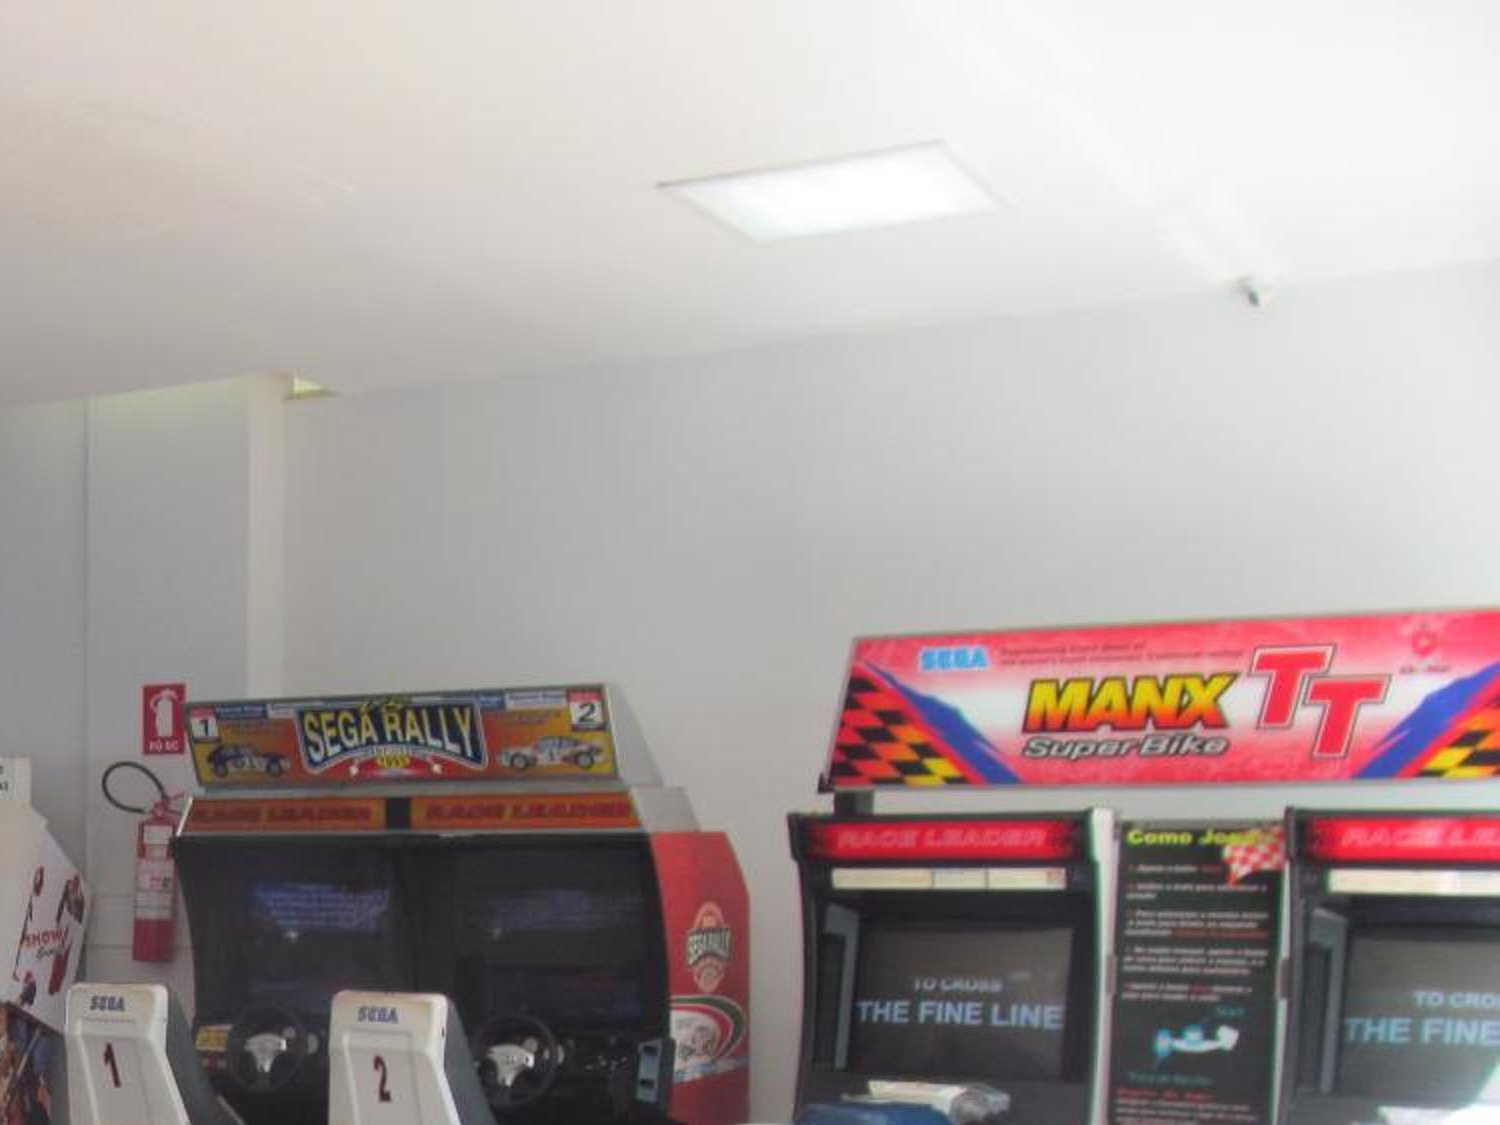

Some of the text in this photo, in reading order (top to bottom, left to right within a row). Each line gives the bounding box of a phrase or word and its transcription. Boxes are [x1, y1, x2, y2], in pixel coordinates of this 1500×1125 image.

[920, 647, 989, 671] SEGA
[1022, 644, 1393, 760] MANX TT
[579, 703, 597, 723] 2
[303, 704, 475, 763] SEGA RALLY
[837, 828, 1048, 849] RACE LEADER
[1127, 829, 1192, 845] Como
[1341, 827, 1444, 848] RACE
[913, 975, 936, 991] TO
[89, 996, 125, 1012] SEGA
[1413, 991, 1444, 1008] TO
[357, 1006, 399, 1024] SEGA
[856, 1000, 1064, 1031] THE FINE LINE
[1348, 1017, 1500, 1046] THE FINE
[104, 1042, 121, 1089] 1
[373, 1055, 392, 1103] 2
